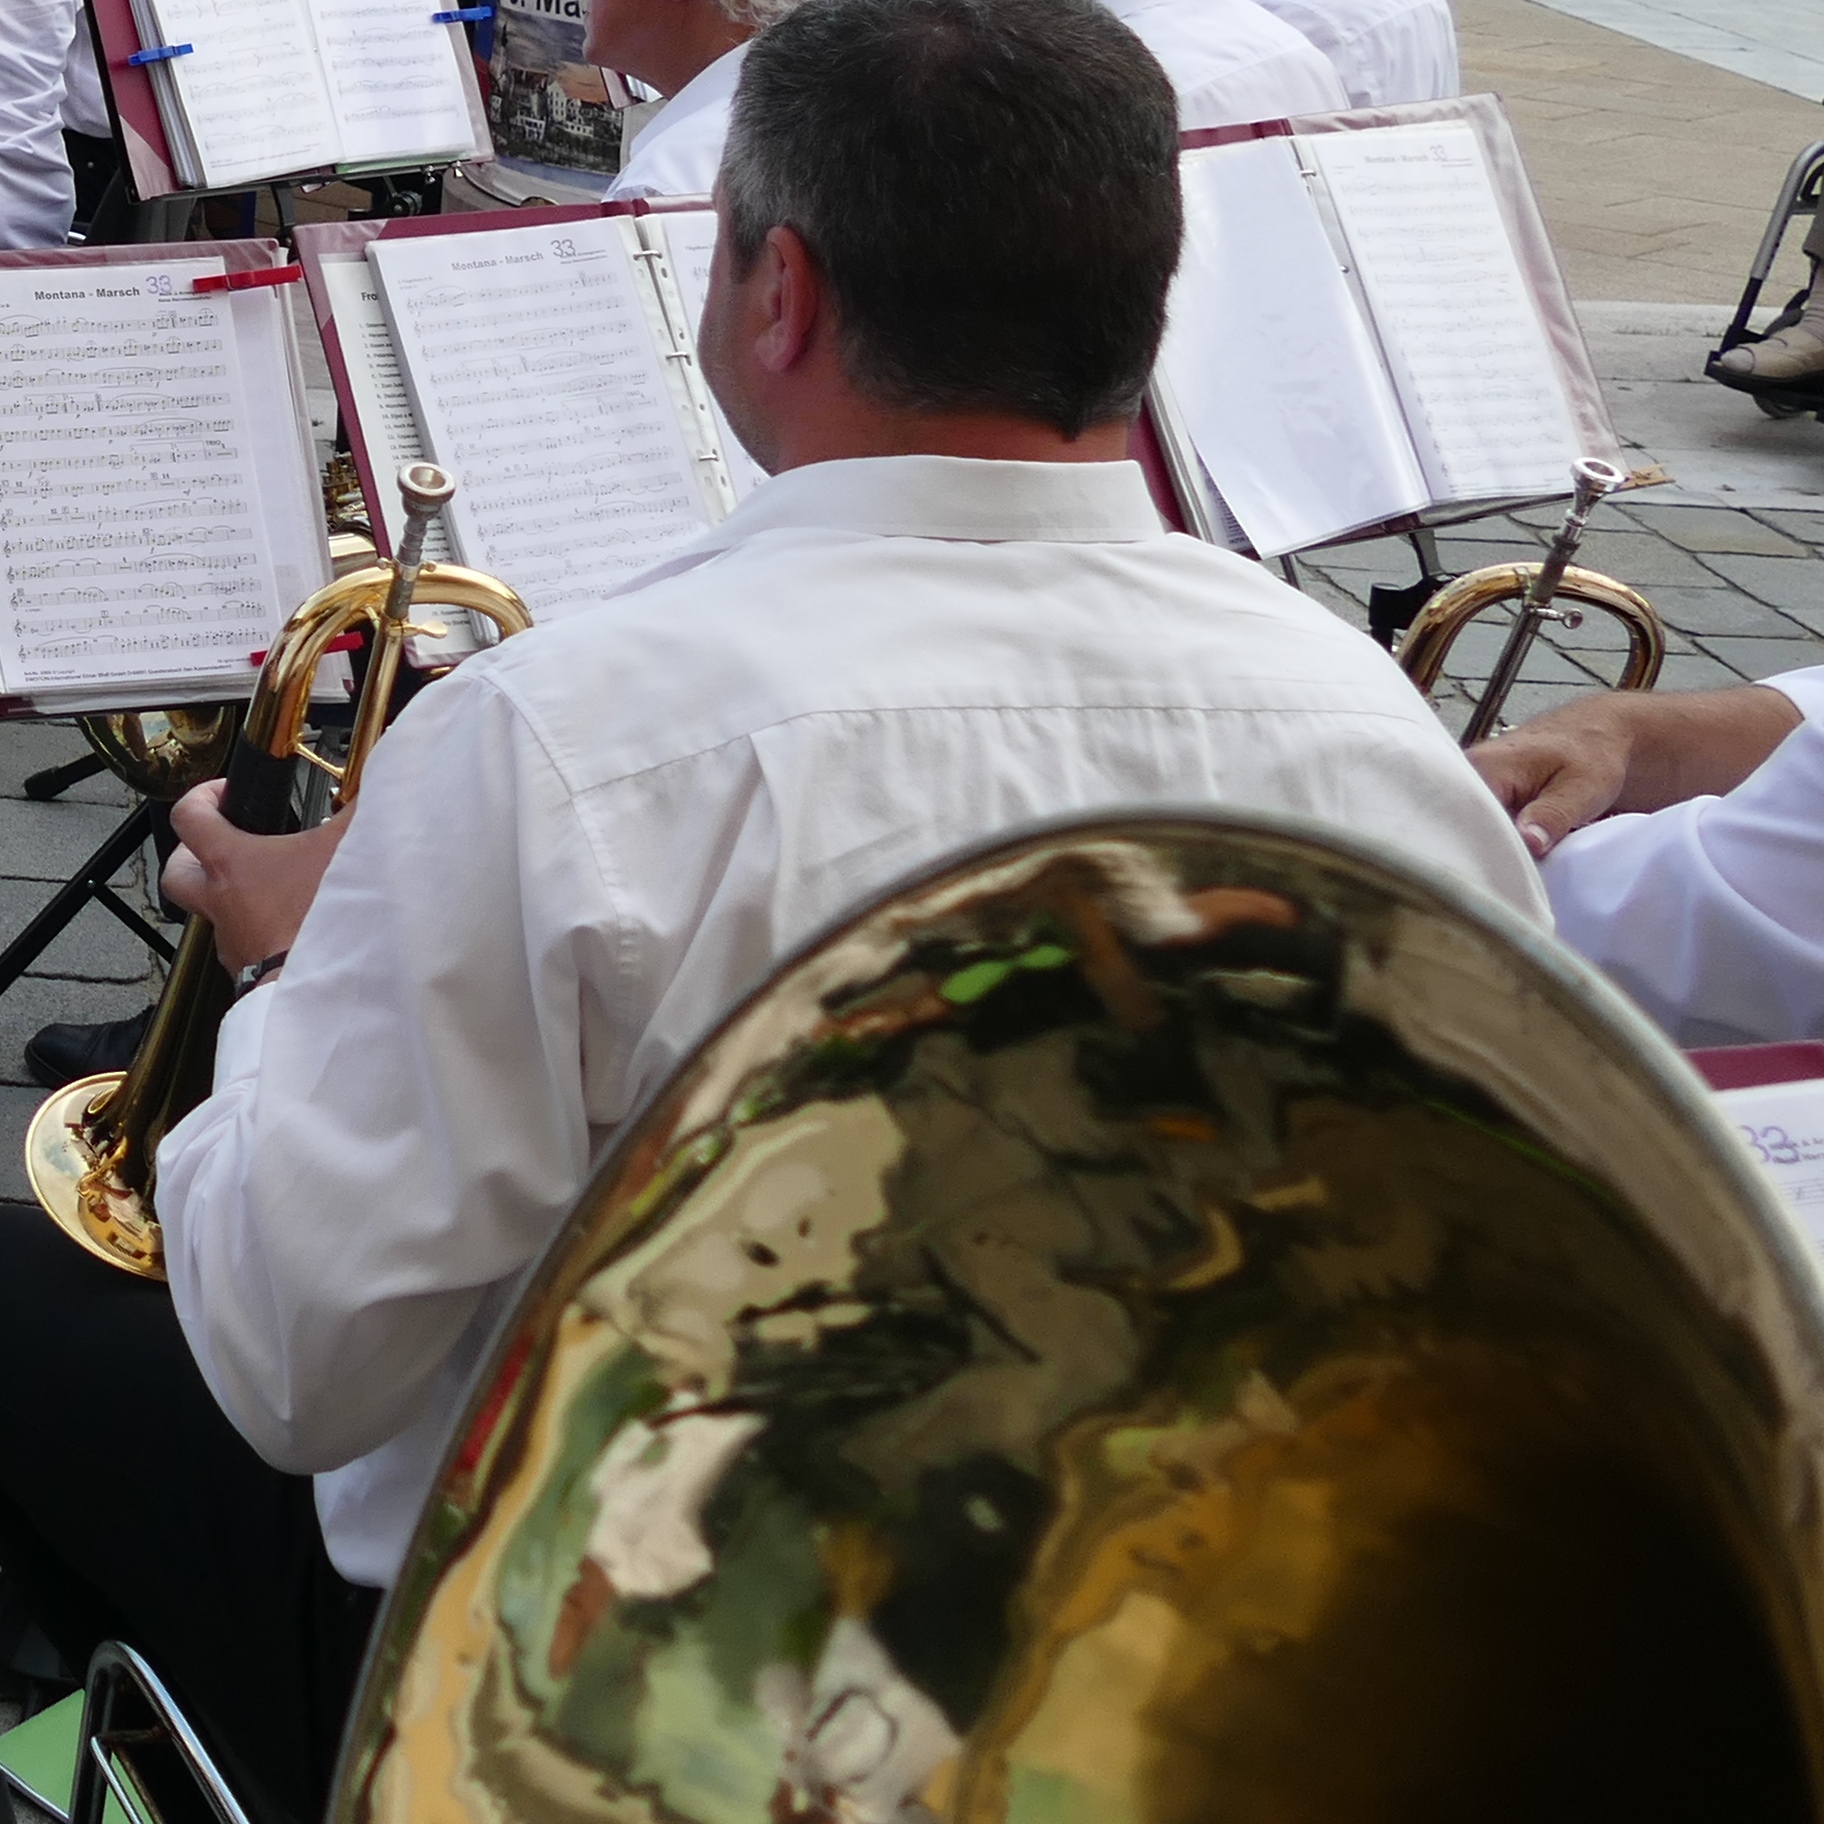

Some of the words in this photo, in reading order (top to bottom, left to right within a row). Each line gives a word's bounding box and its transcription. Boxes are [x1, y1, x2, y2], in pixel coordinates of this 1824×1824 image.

[551, 239, 576, 258] 33
[452, 259, 497, 271] Montana
[505, 253, 544, 264] Marsch
[34, 290, 86, 301] Montana
[96, 287, 140, 298] Marsch
